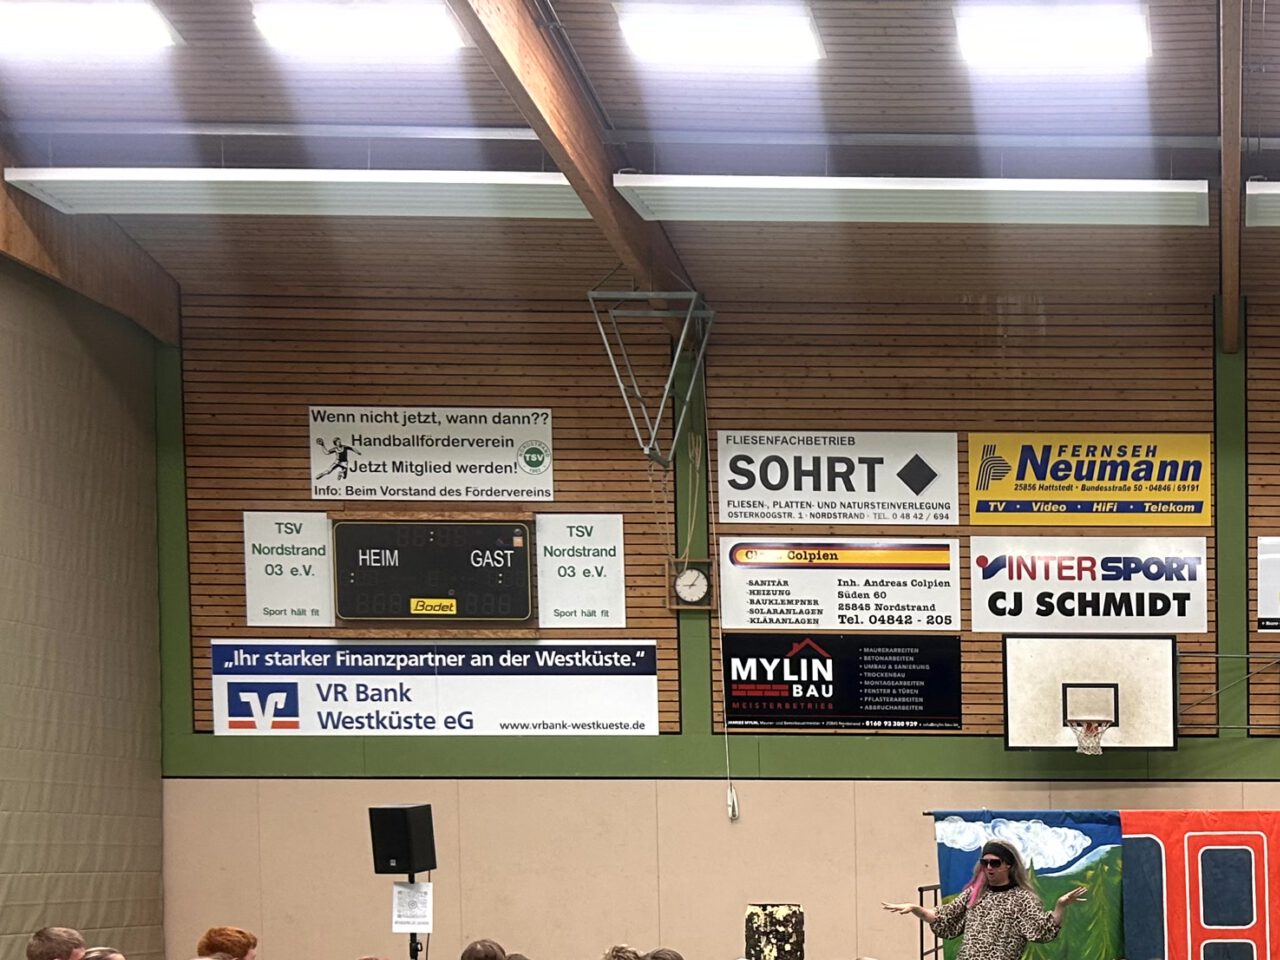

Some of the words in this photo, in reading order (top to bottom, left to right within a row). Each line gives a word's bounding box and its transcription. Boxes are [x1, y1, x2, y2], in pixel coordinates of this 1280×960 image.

[311, 410, 355, 423] Wenn
[360, 411, 399, 424] nicht
[401, 411, 441, 426] jetzt,
[445, 414, 488, 425] wann
[492, 412, 549, 425] dann??
[351, 434, 514, 448] Handballförderverein
[726, 435, 856, 446] FLIESENFACHBETRIEB
[524, 453, 544, 461] TSV
[1057, 445, 1158, 458] FERNSEH
[349, 460, 387, 473] Jetzt
[392, 461, 451, 476] Mitglied
[455, 462, 518, 474] werden!
[1015, 444, 1203, 482] Neumann
[727, 454, 885, 493] SOHRT
[314, 486, 342, 496] Info:
[346, 486, 377, 496] Beim
[380, 486, 436, 496] Vorstand
[440, 486, 462, 497] des
[465, 486, 551, 497] Fördervereins
[1014, 483, 1037, 492] 25856
[1038, 484, 1074, 492] Hattstedt
[1081, 484, 1132, 492] Bundesstraße
[1133, 484, 1143, 492] 50
[1177, 484, 1200, 492] 69191
[727, 500, 769, 509] FLIESEN-,
[773, 500, 814, 509] PLATTEN-
[817, 501, 837, 509] UND
[840, 501, 951, 510] NATURSTEINVERLEGUNG
[989, 502, 1007, 512] TV
[1032, 502, 1067, 512] Video
[1093, 502, 1118, 512] HiFi
[1144, 502, 1195, 512] Telekom
[728, 511, 796, 519] OSTERKOOGSTR.
[810, 512, 865, 520] NORDSTRAND
[873, 512, 890, 520] TEL.
[274, 522, 303, 534] TSV
[566, 526, 594, 538] TSV
[252, 543, 326, 556] Nordstrand
[543, 546, 616, 558] Nordstrand
[358, 549, 399, 567] HEIM
[470, 550, 515, 568] GAST
[787, 550, 839, 562] Colpien
[264, 564, 284, 576] 03
[290, 564, 315, 576] e.V.
[557, 566, 576, 578] 03
[582, 566, 607, 578] e.V.
[837, 579, 860, 587] Inh.
[864, 579, 908, 588] Andreas
[910, 579, 952, 590] Colpien
[837, 590, 870, 599] Süden
[873, 591, 887, 599] 60
[413, 600, 454, 612] Bodet
[838, 602, 871, 611] 25845
[874, 603, 936, 612] Nordstrand
[988, 591, 1023, 617] CJ
[1035, 591, 1191, 617] SCHMIDT
[263, 607, 287, 617] Sport
[290, 608, 307, 616] hält
[311, 608, 320, 616] fit
[554, 608, 577, 618] Sport
[580, 609, 597, 618] hält
[600, 609, 610, 618] fit
[837, 614, 864, 624] Tel.
[868, 614, 913, 624] 04842
[926, 615, 952, 625] 205
[224, 650, 260, 668] „Ihr
[264, 650, 331, 667] starker
[336, 650, 465, 670] Finanzpartner
[470, 654, 494, 667] an
[499, 650, 530, 667] der
[535, 650, 646, 667] Westküste.“
[730, 657, 834, 682] MYLIN
[316, 683, 348, 702] VR
[356, 682, 413, 702] Bank
[792, 684, 834, 698] BAU
[732, 702, 834, 710] MEISTERBETRIEB
[317, 710, 436, 730] Westküste
[444, 711, 474, 730] eG
[499, 720, 646, 730] www.vrbank-westkueste.de
